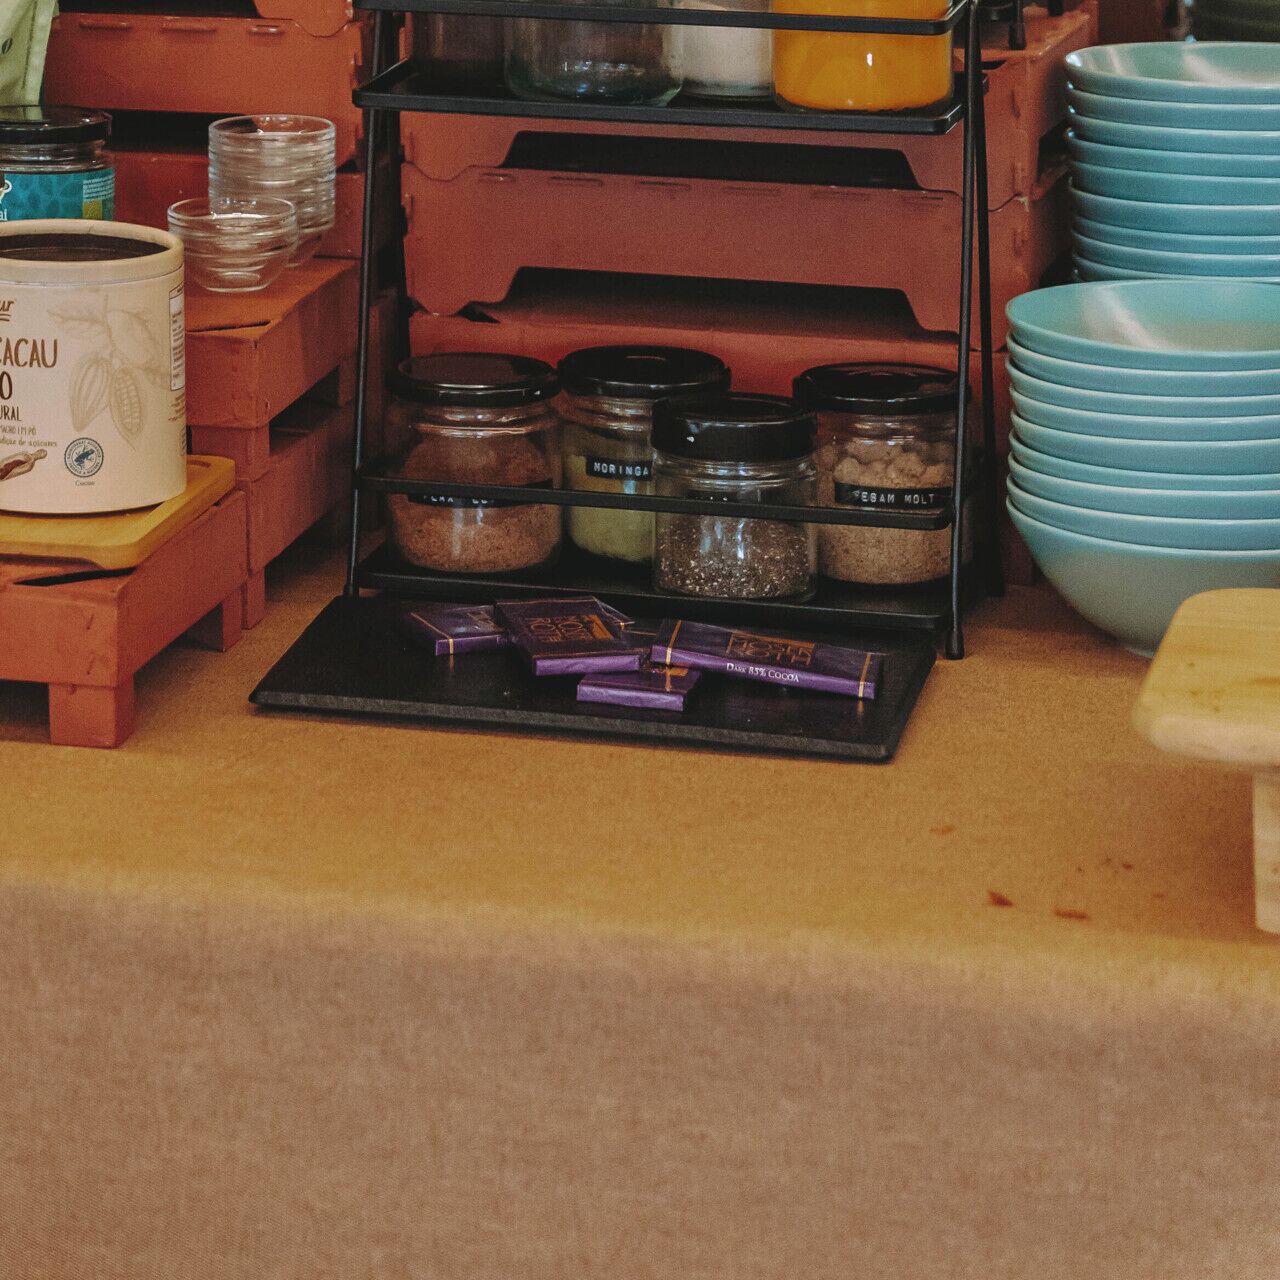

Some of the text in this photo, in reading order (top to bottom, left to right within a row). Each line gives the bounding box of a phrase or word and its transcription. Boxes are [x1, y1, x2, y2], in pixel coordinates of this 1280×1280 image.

[593, 462, 649, 477] MORINGA
[904, 493, 935, 505] MOLT
[748, 666, 767, 677] 85%
